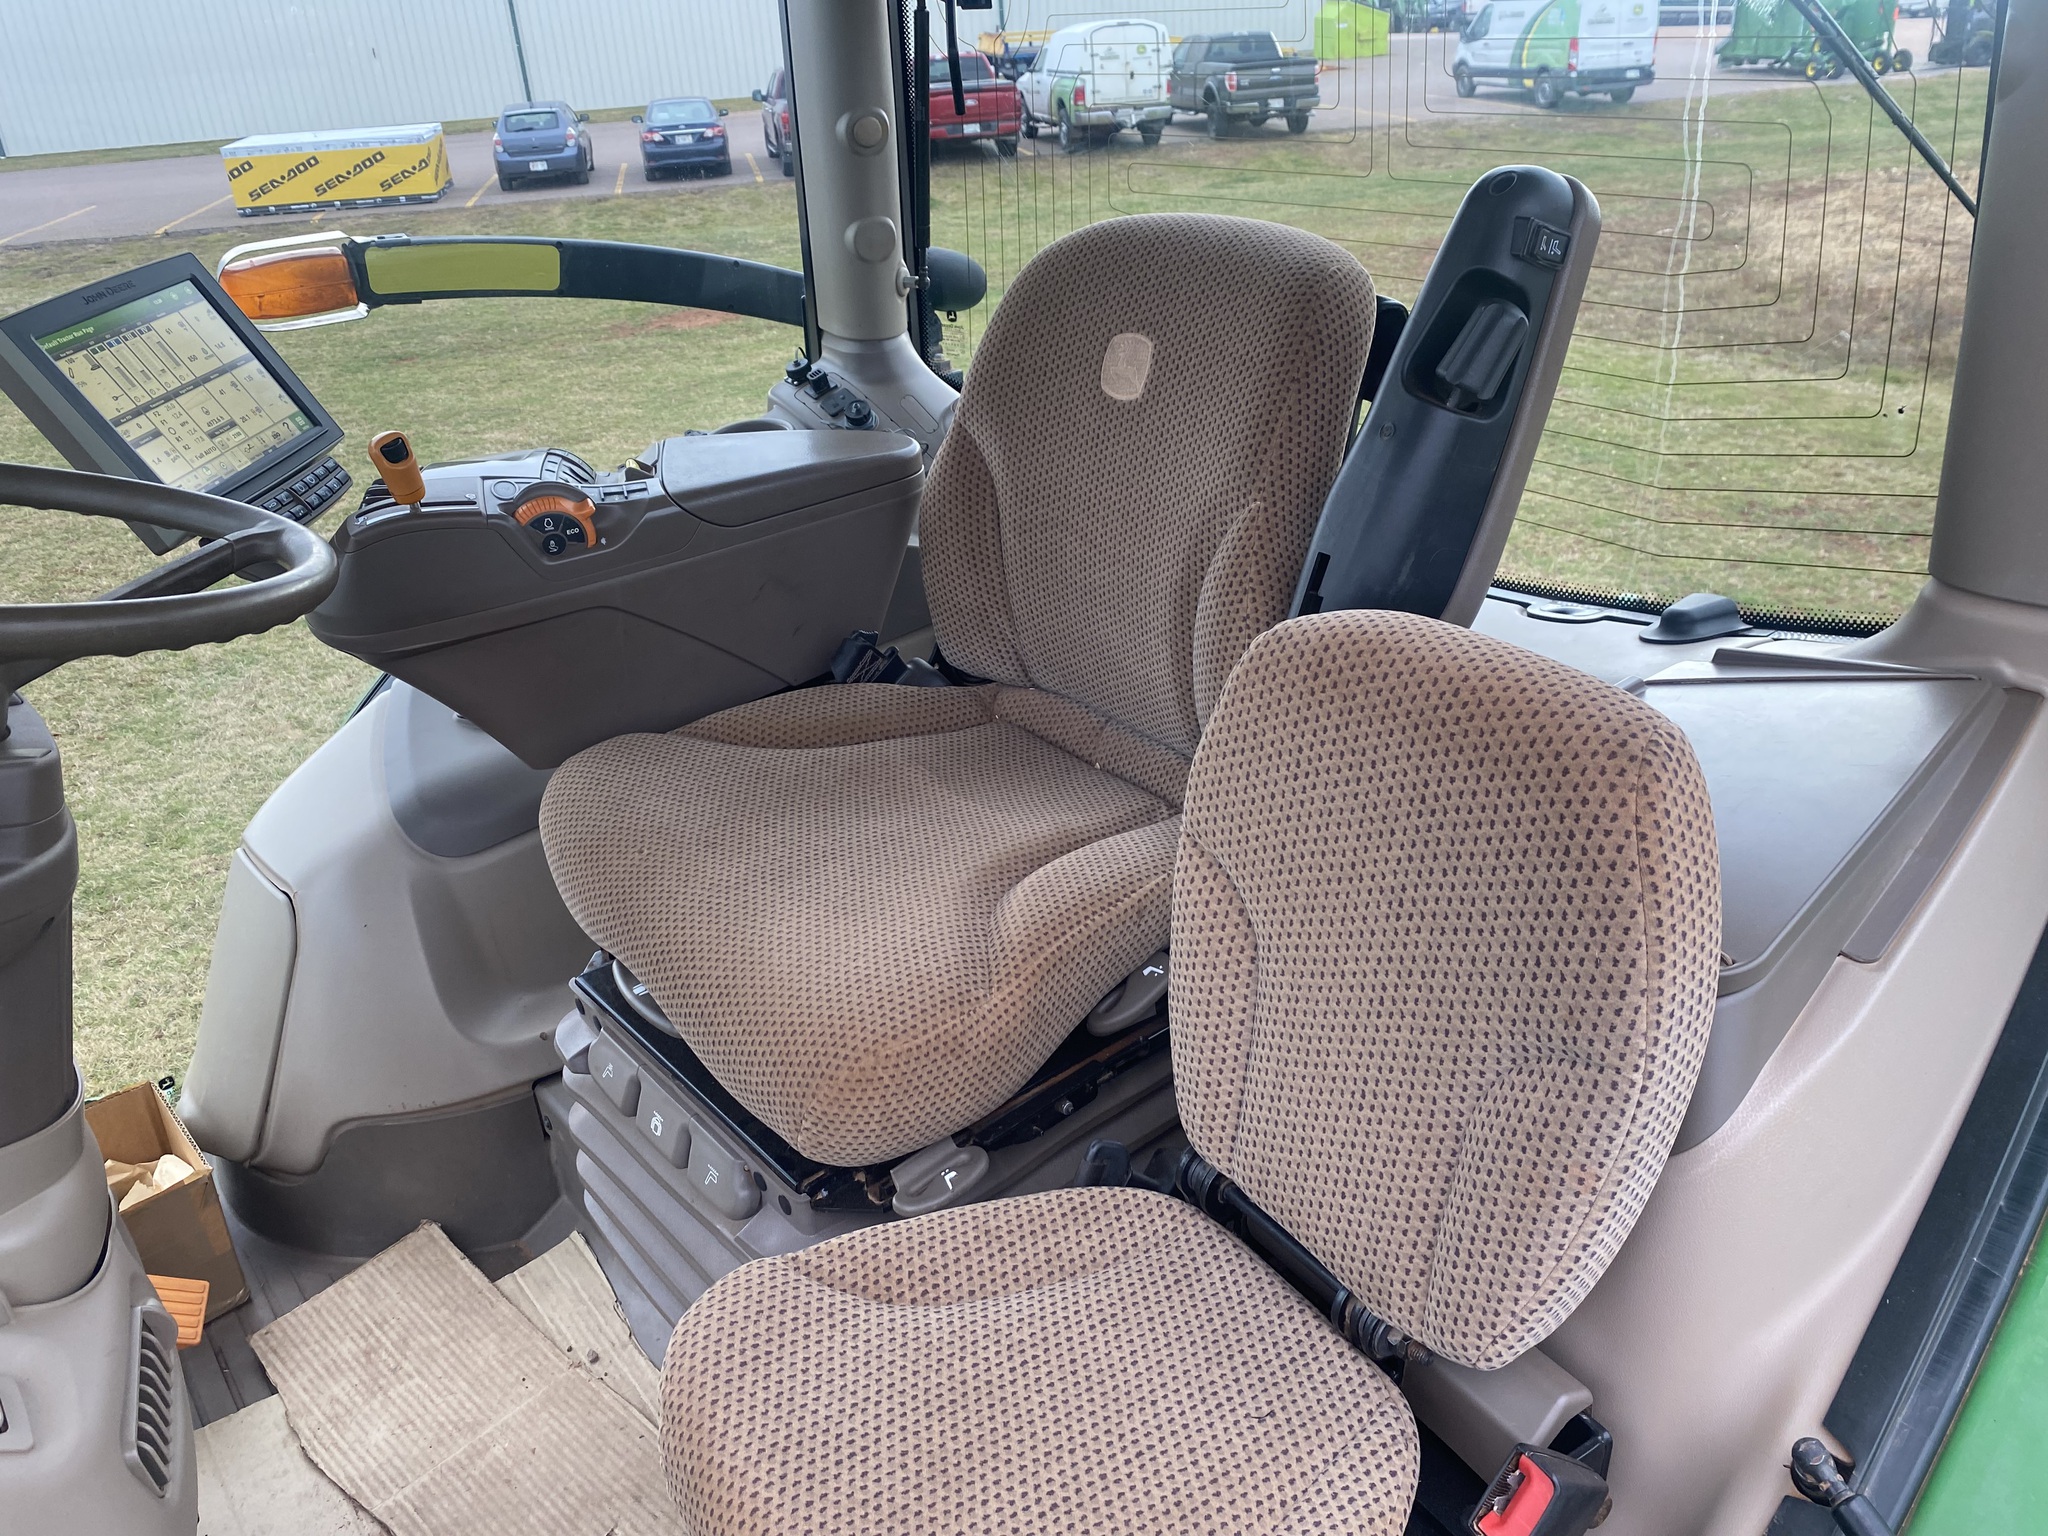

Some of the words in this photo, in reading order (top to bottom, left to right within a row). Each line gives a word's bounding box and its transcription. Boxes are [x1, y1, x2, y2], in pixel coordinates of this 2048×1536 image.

[82, 289, 108, 305] JOHN
[106, 280, 136, 296] DEERE
[203, 446, 218, 456] AUTO
[566, 527, 580, 535] ECO
